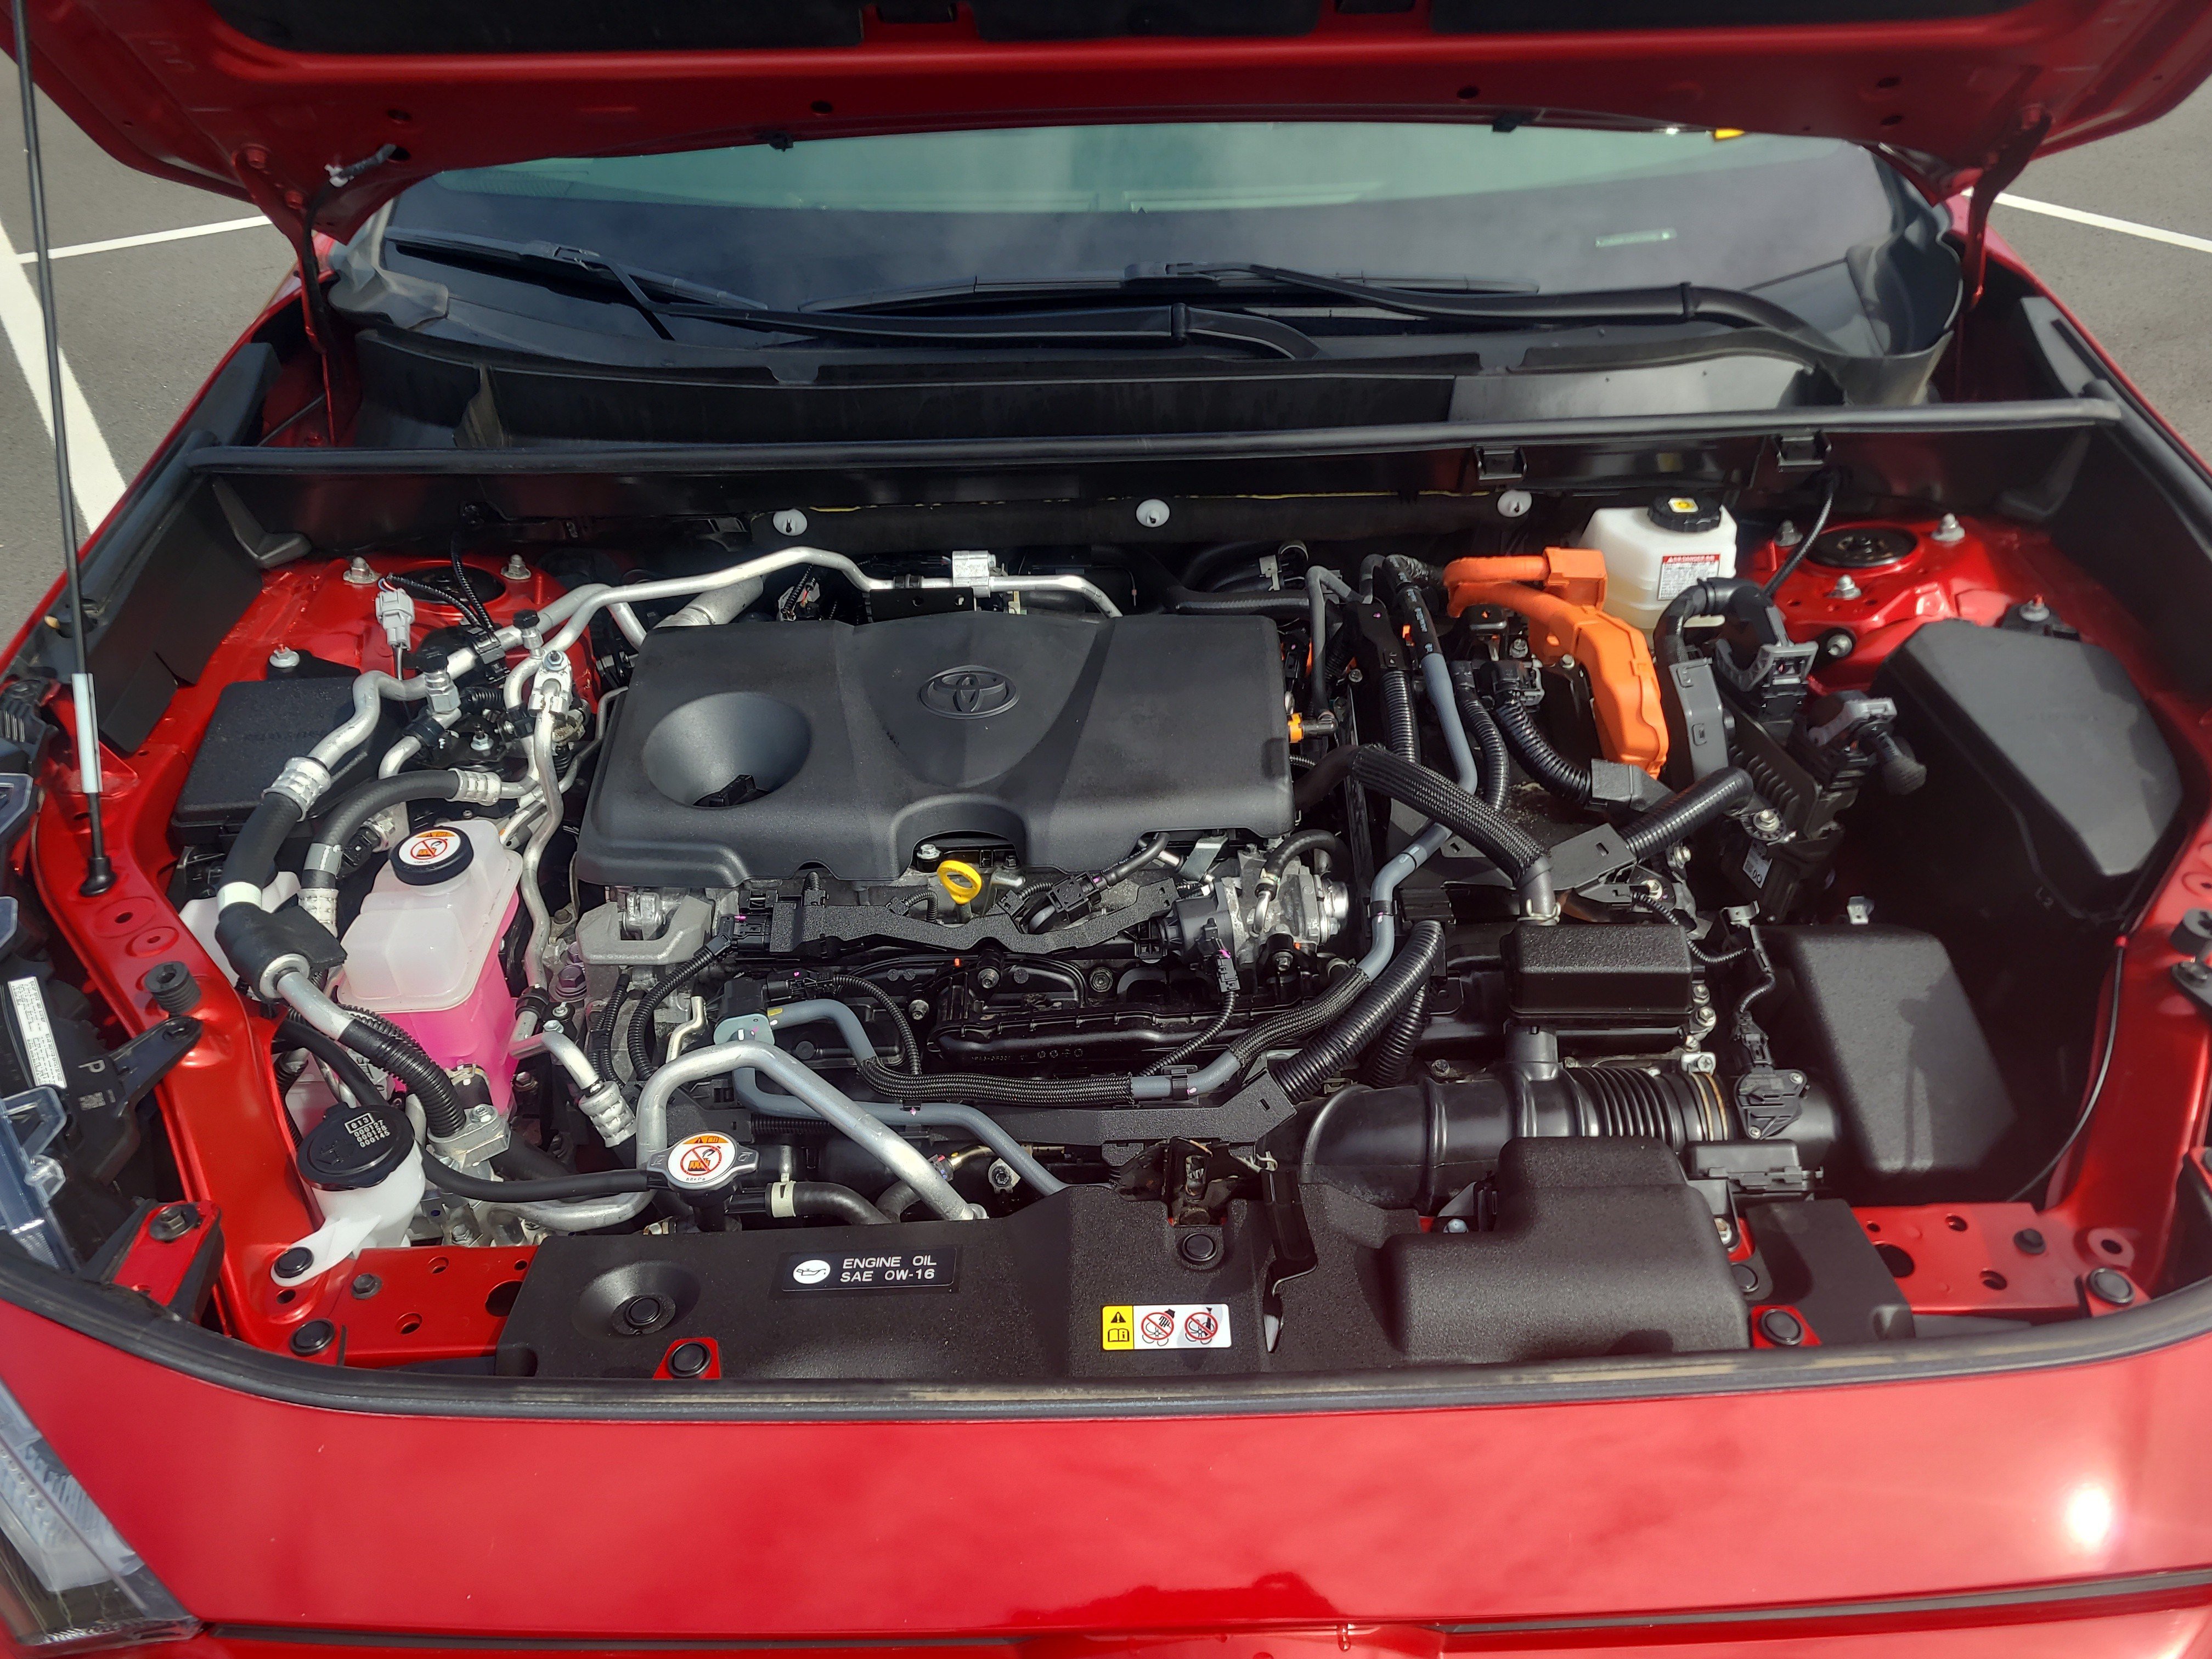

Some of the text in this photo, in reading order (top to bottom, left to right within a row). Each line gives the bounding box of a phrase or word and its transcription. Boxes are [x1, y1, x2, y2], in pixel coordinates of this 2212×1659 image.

[78, 1060, 105, 1072] P
[354, 1120, 383, 1137] 000127
[360, 1131, 390, 1148] 000145
[843, 1255, 936, 1268] ENGINE OIL
[840, 1269, 935, 1282] SAE 0W-16
